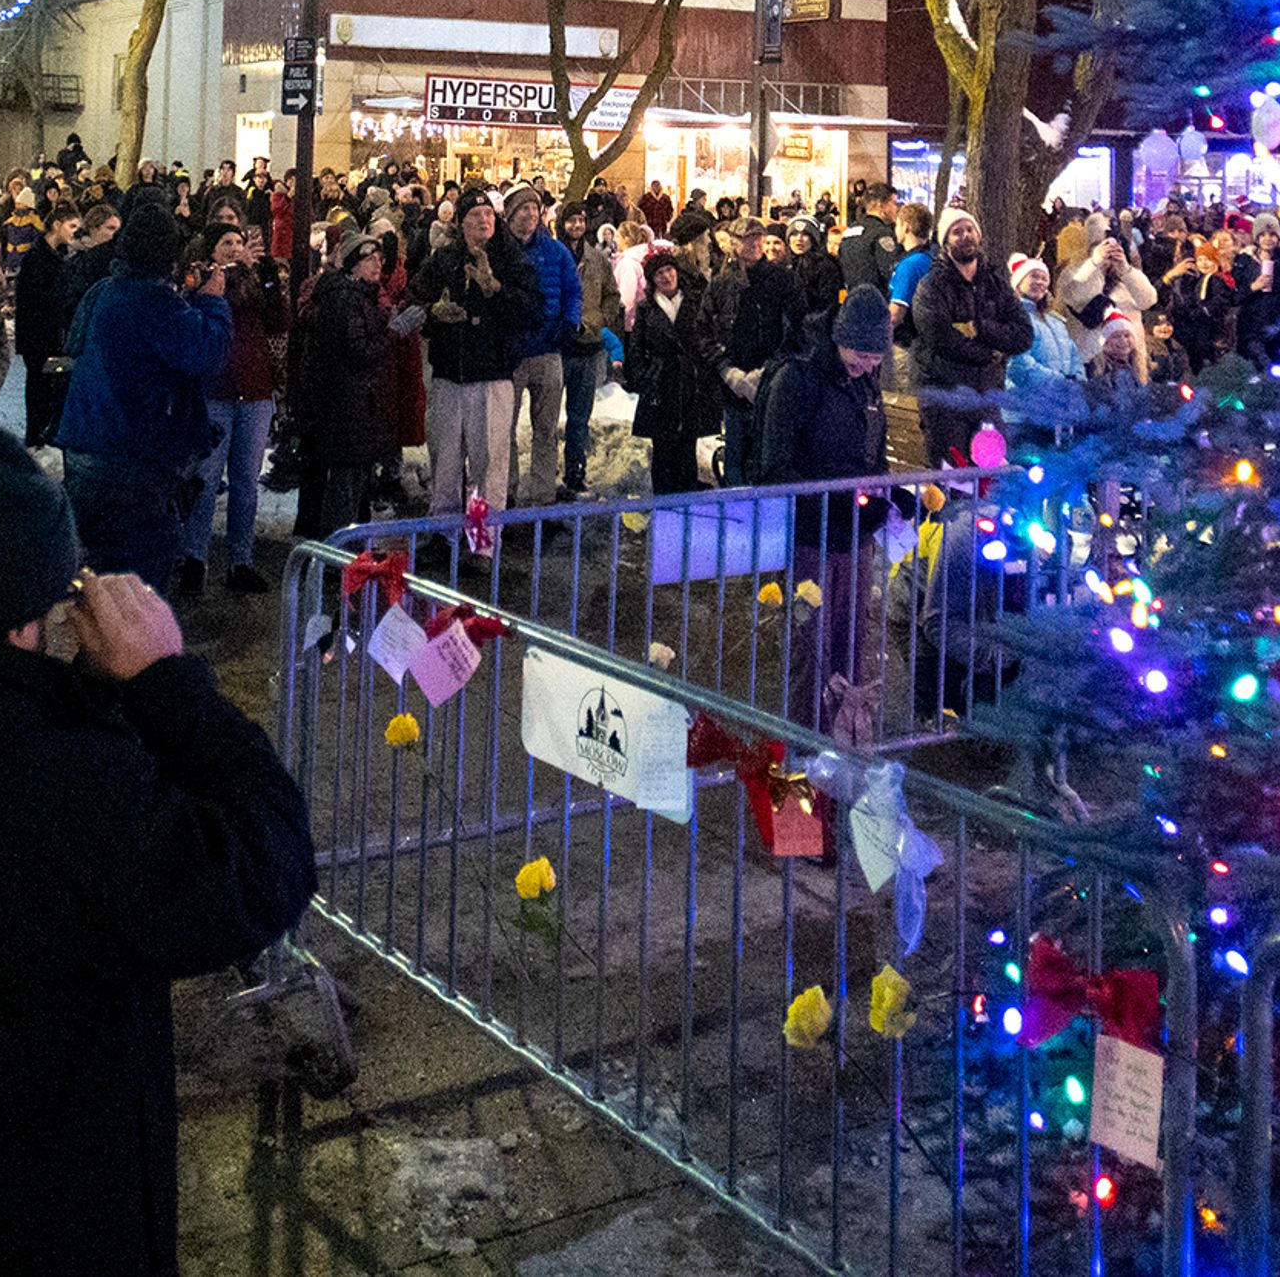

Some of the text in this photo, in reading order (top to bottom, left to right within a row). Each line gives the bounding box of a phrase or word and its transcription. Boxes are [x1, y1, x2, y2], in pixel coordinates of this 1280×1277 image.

[289, 67, 308, 78] PUBLIC
[284, 79, 313, 90] RESTROOM
[431, 79, 558, 110] HYPERSPU
[431, 106, 543, 123] SPORT
[579, 743, 625, 771] MOSCOW
